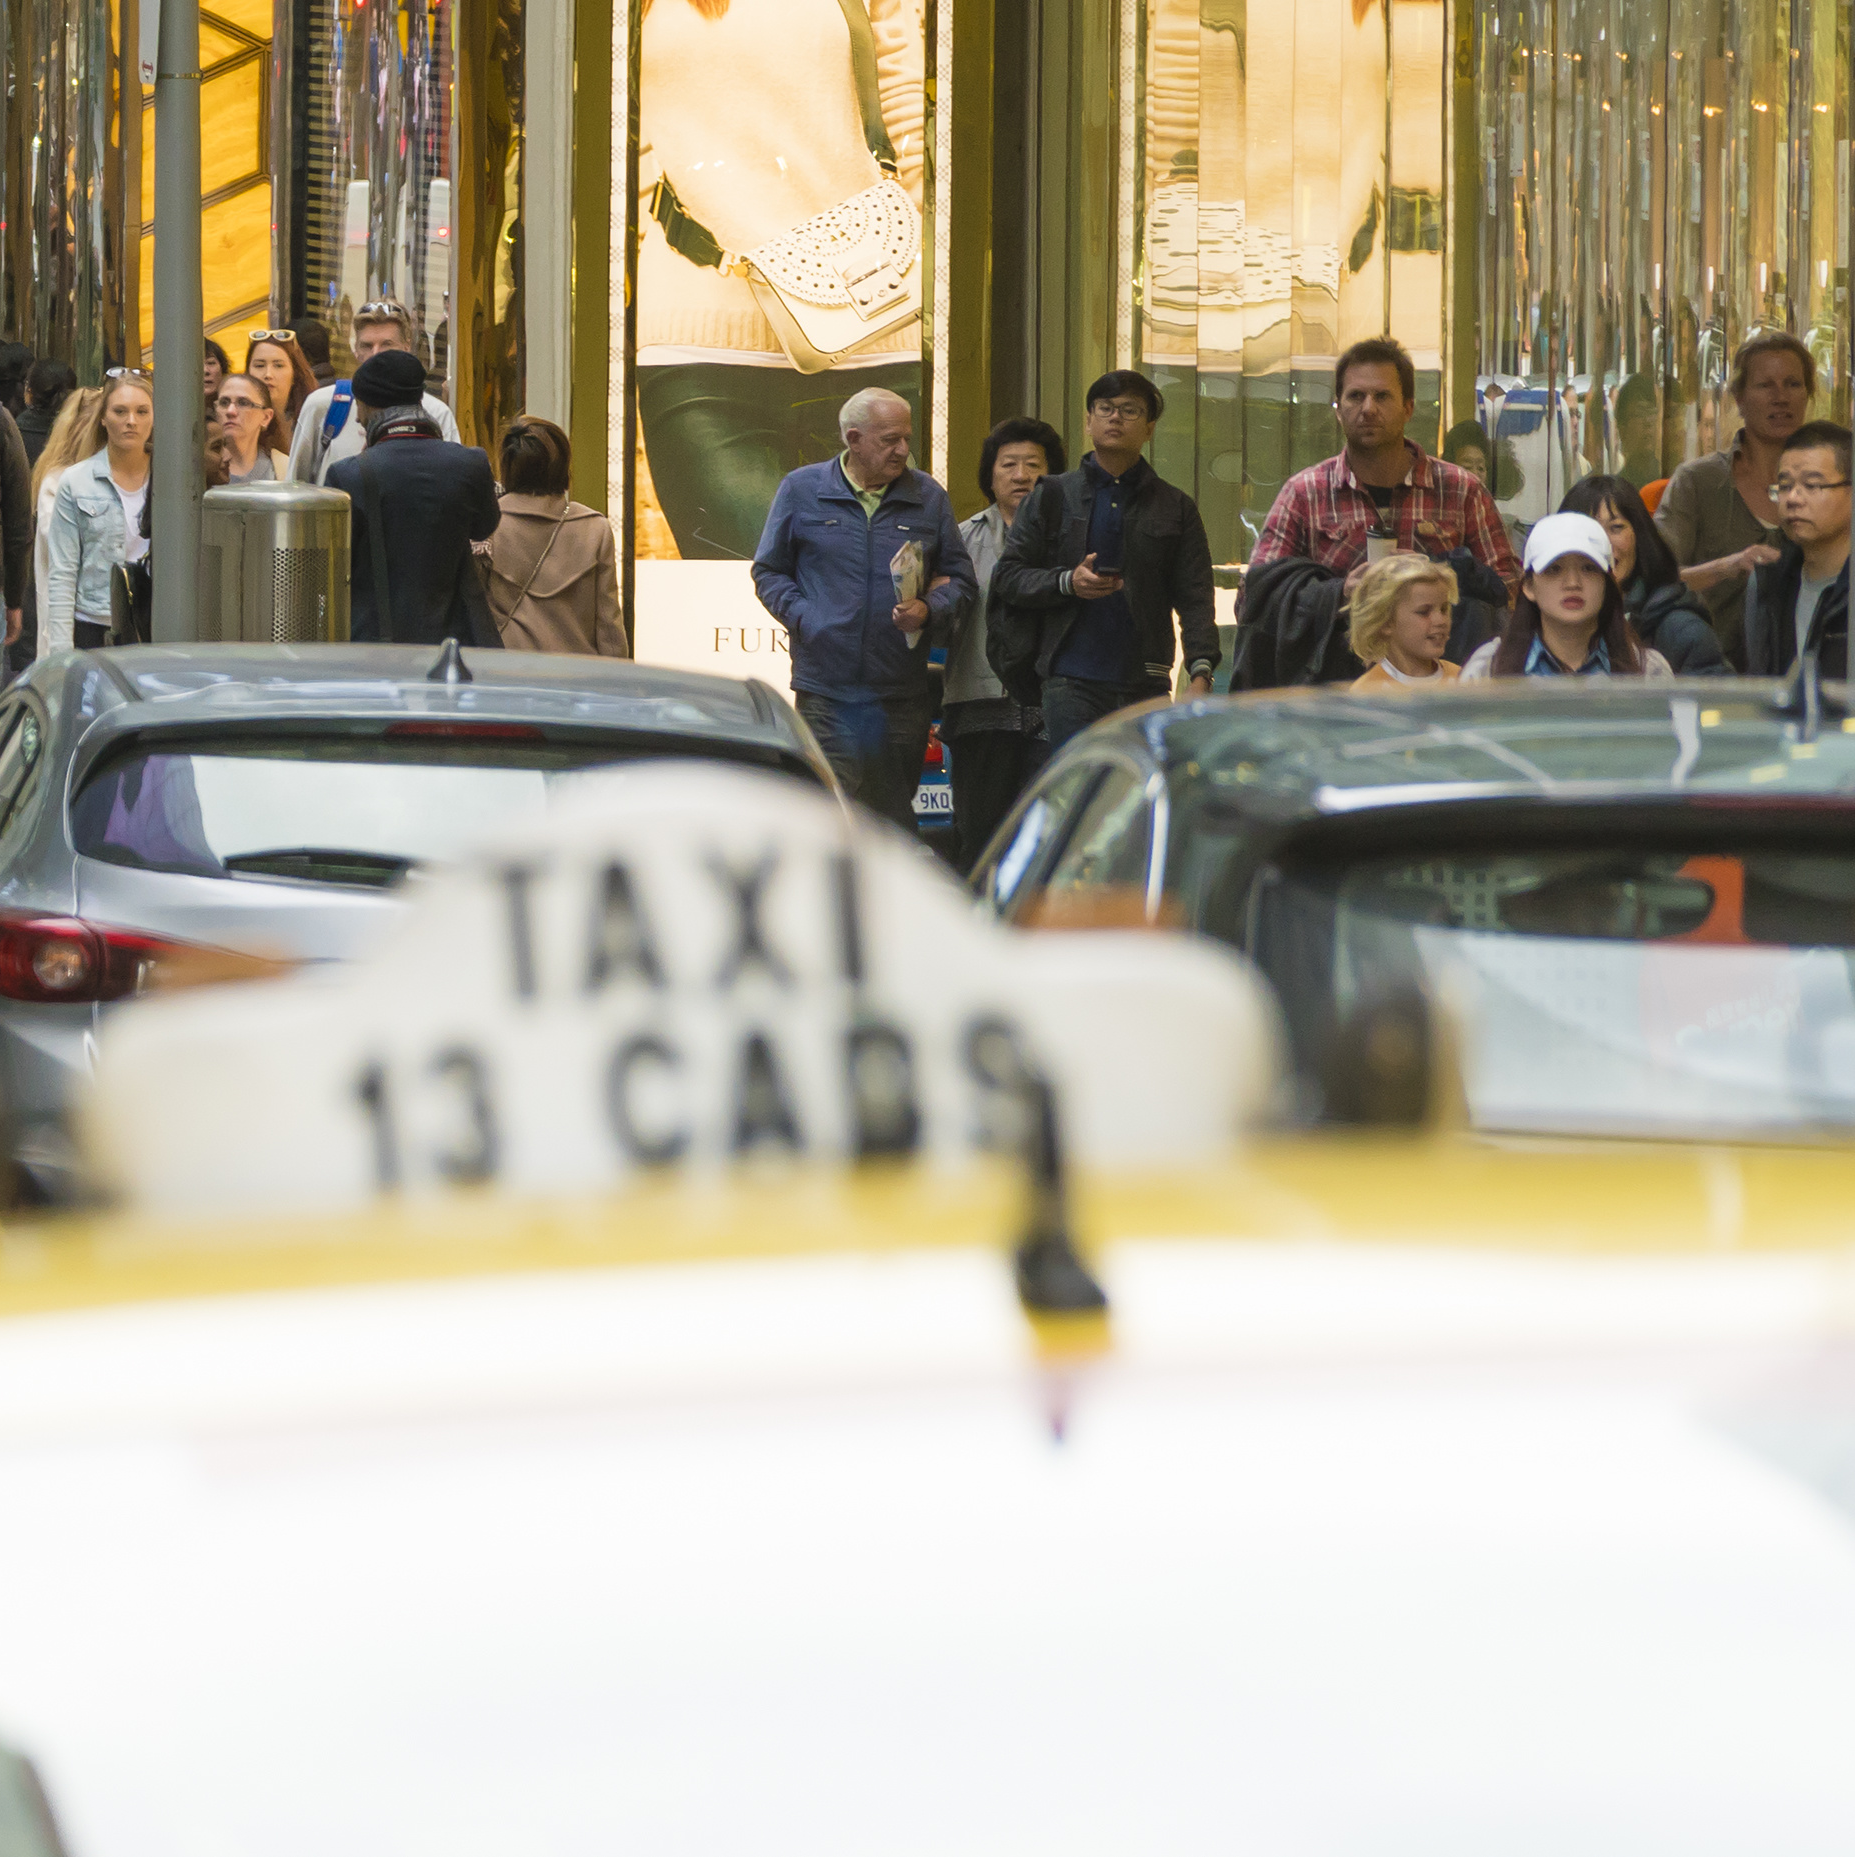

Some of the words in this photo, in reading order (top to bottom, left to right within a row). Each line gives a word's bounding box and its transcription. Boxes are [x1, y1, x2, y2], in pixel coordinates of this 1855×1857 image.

[712, 626, 790, 654] FUR
[489, 850, 869, 1006] TAXI
[354, 1047, 501, 1194] 13
